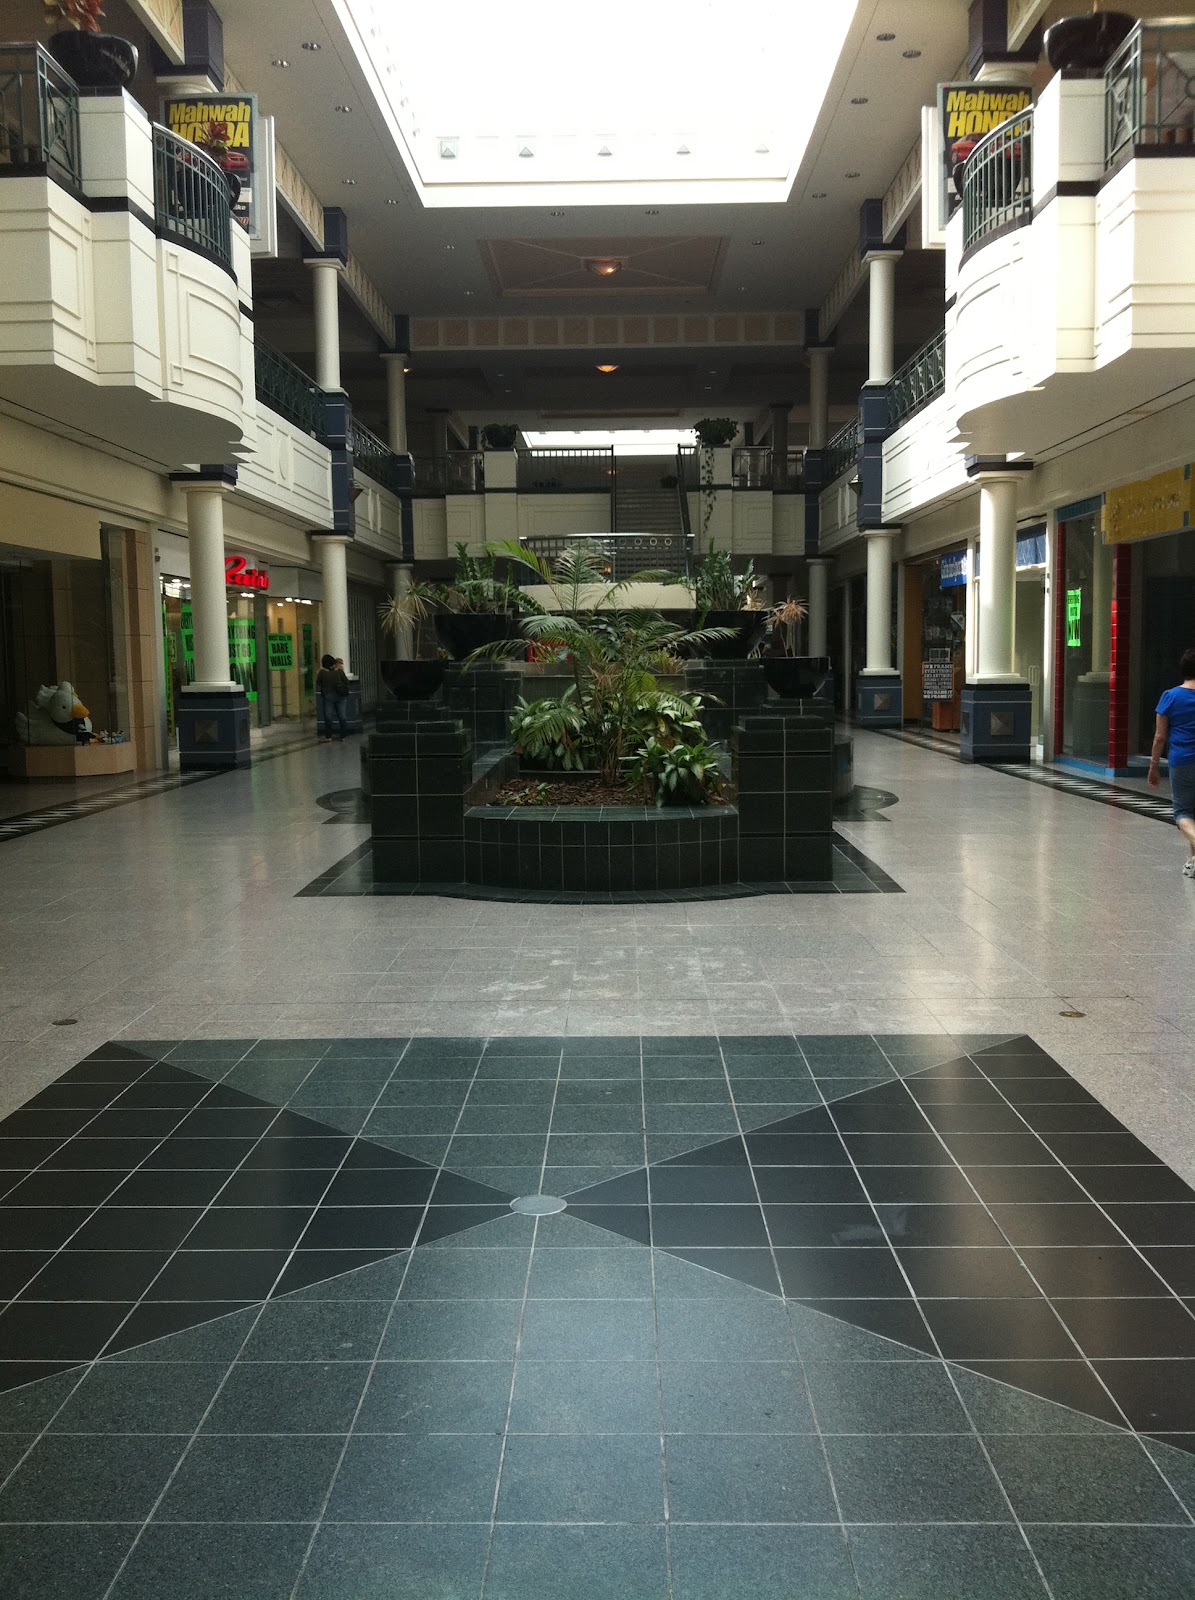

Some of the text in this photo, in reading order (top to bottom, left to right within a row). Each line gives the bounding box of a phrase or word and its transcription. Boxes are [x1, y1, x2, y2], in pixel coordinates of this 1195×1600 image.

[946, 90, 1030, 112] Mahwah
[169, 101, 251, 124] Mahwah
[271, 642, 289, 654] BARE
[270, 655, 292, 666] WALLS
